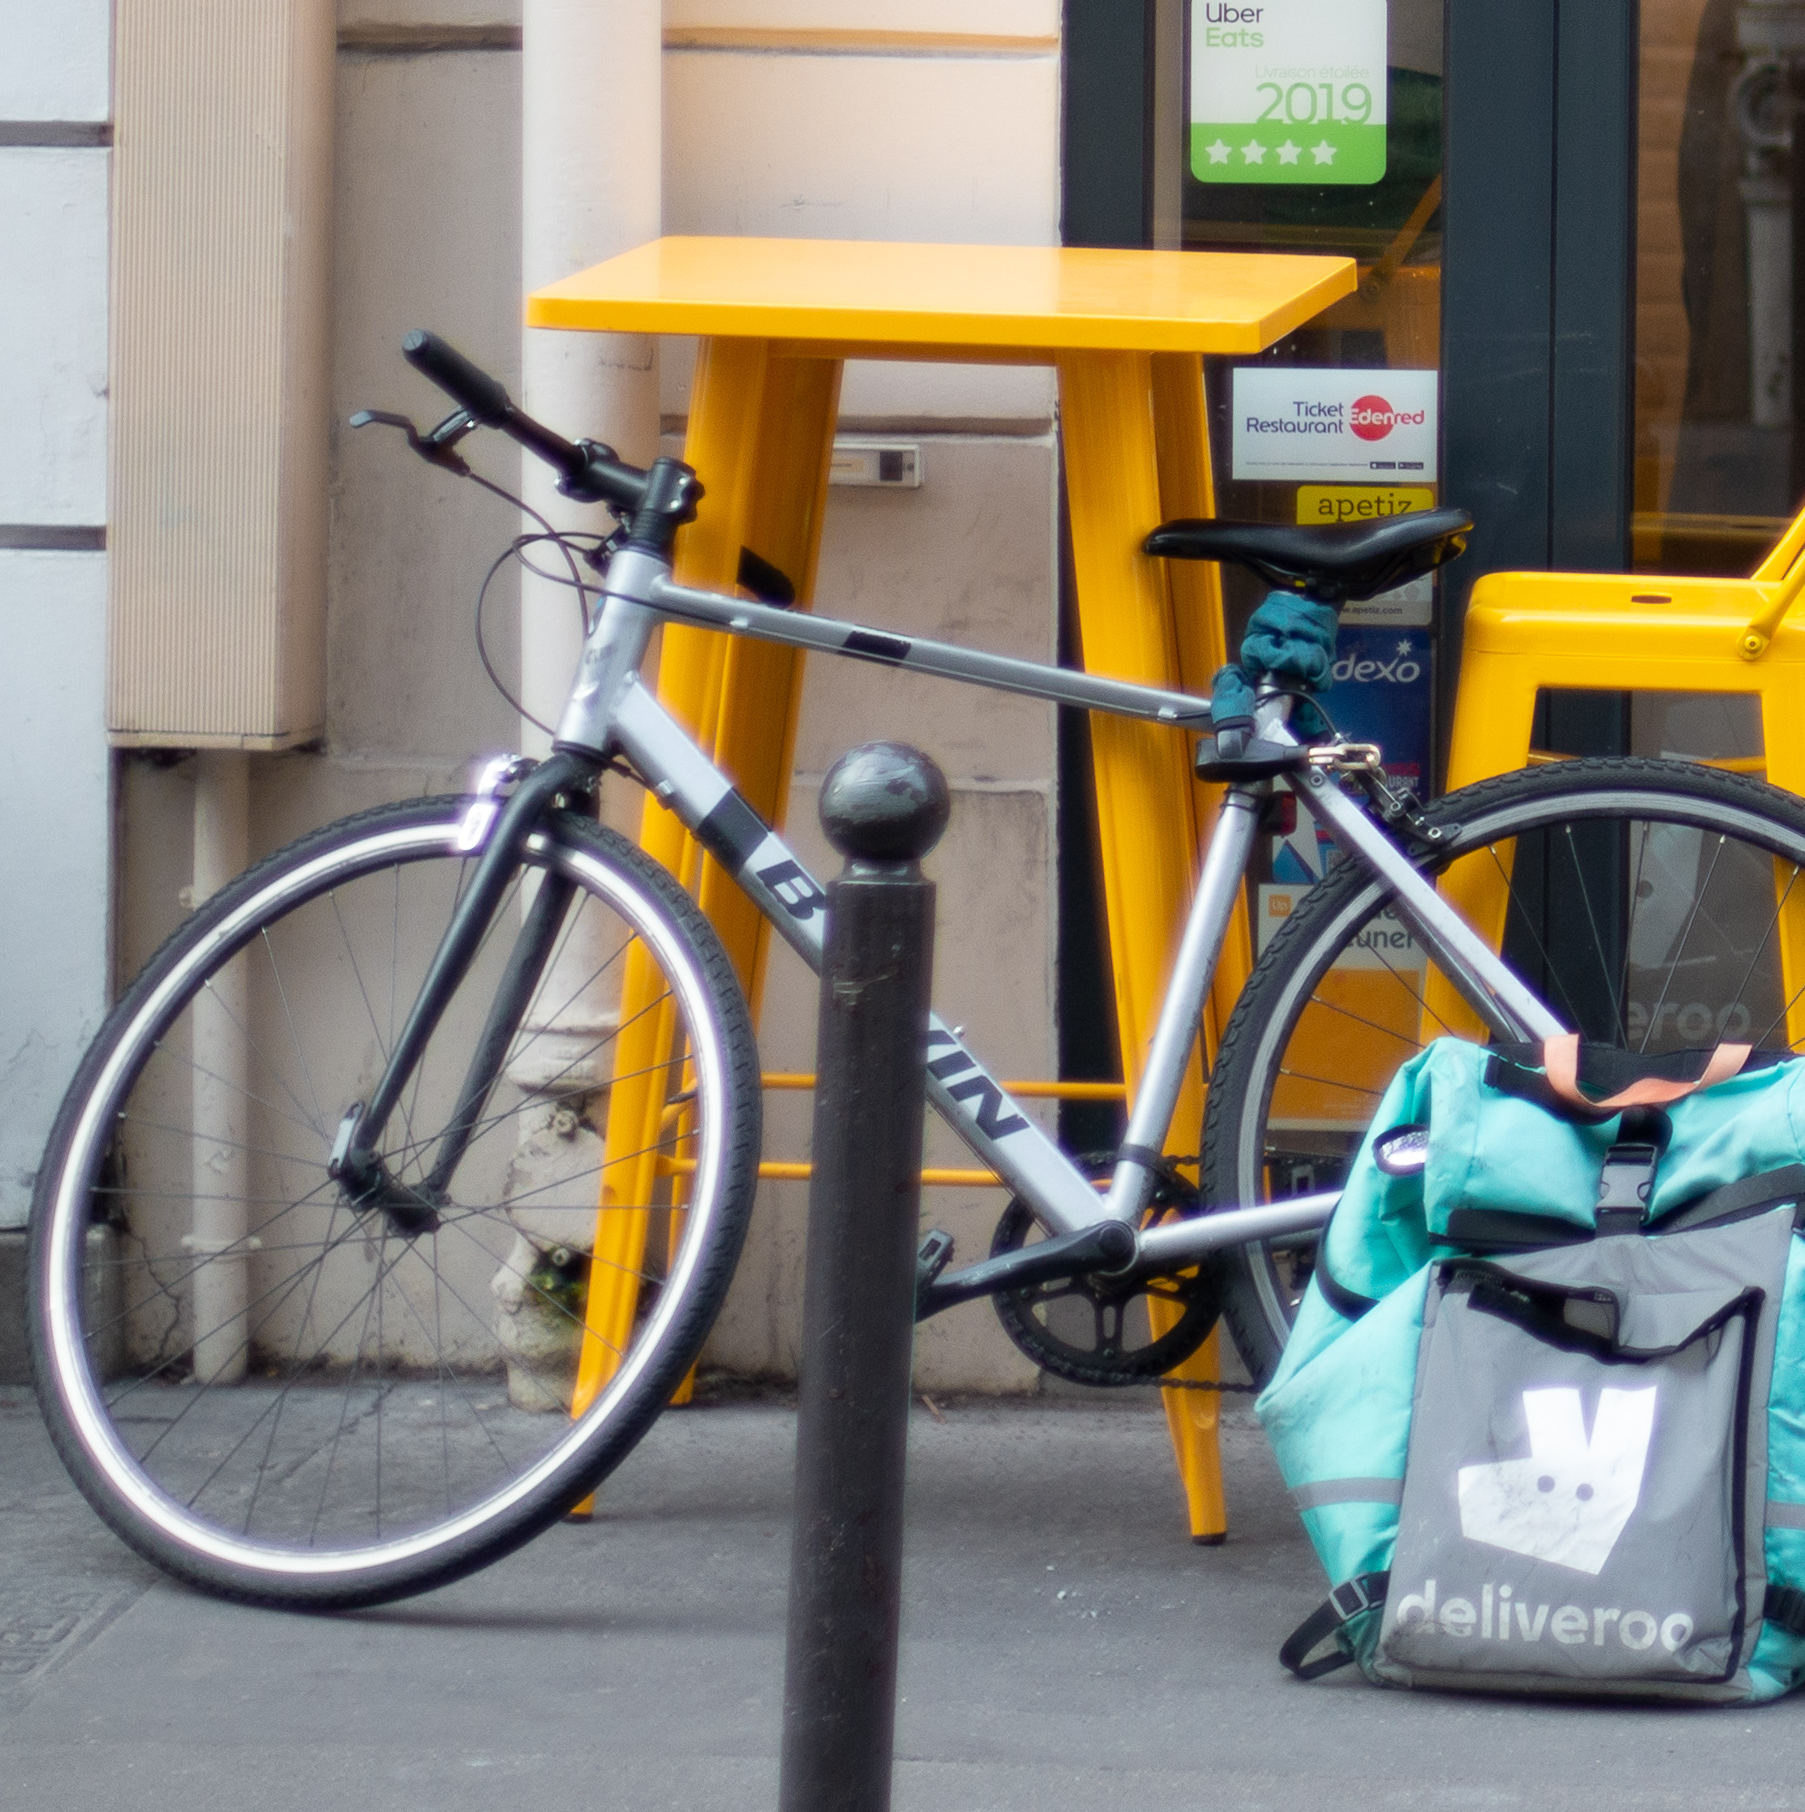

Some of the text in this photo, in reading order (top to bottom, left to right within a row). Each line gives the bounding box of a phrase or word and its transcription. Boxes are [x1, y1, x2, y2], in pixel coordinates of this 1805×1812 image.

[1205, 3, 1264, 23] Uber
[1205, 28, 1264, 48] Eats
[1255, 64, 1370, 79] Livraison étoilée
[1255, 83, 1372, 125] 2019
[1293, 401, 1343, 417] Ticket
[1350, 409, 1424, 425] Edenred
[1247, 418, 1343, 434] Restaurant
[1318, 493, 1412, 522] apetiz
[1331, 653, 1420, 683] dexo
[1396, 1579, 1695, 1651] deliveroo
